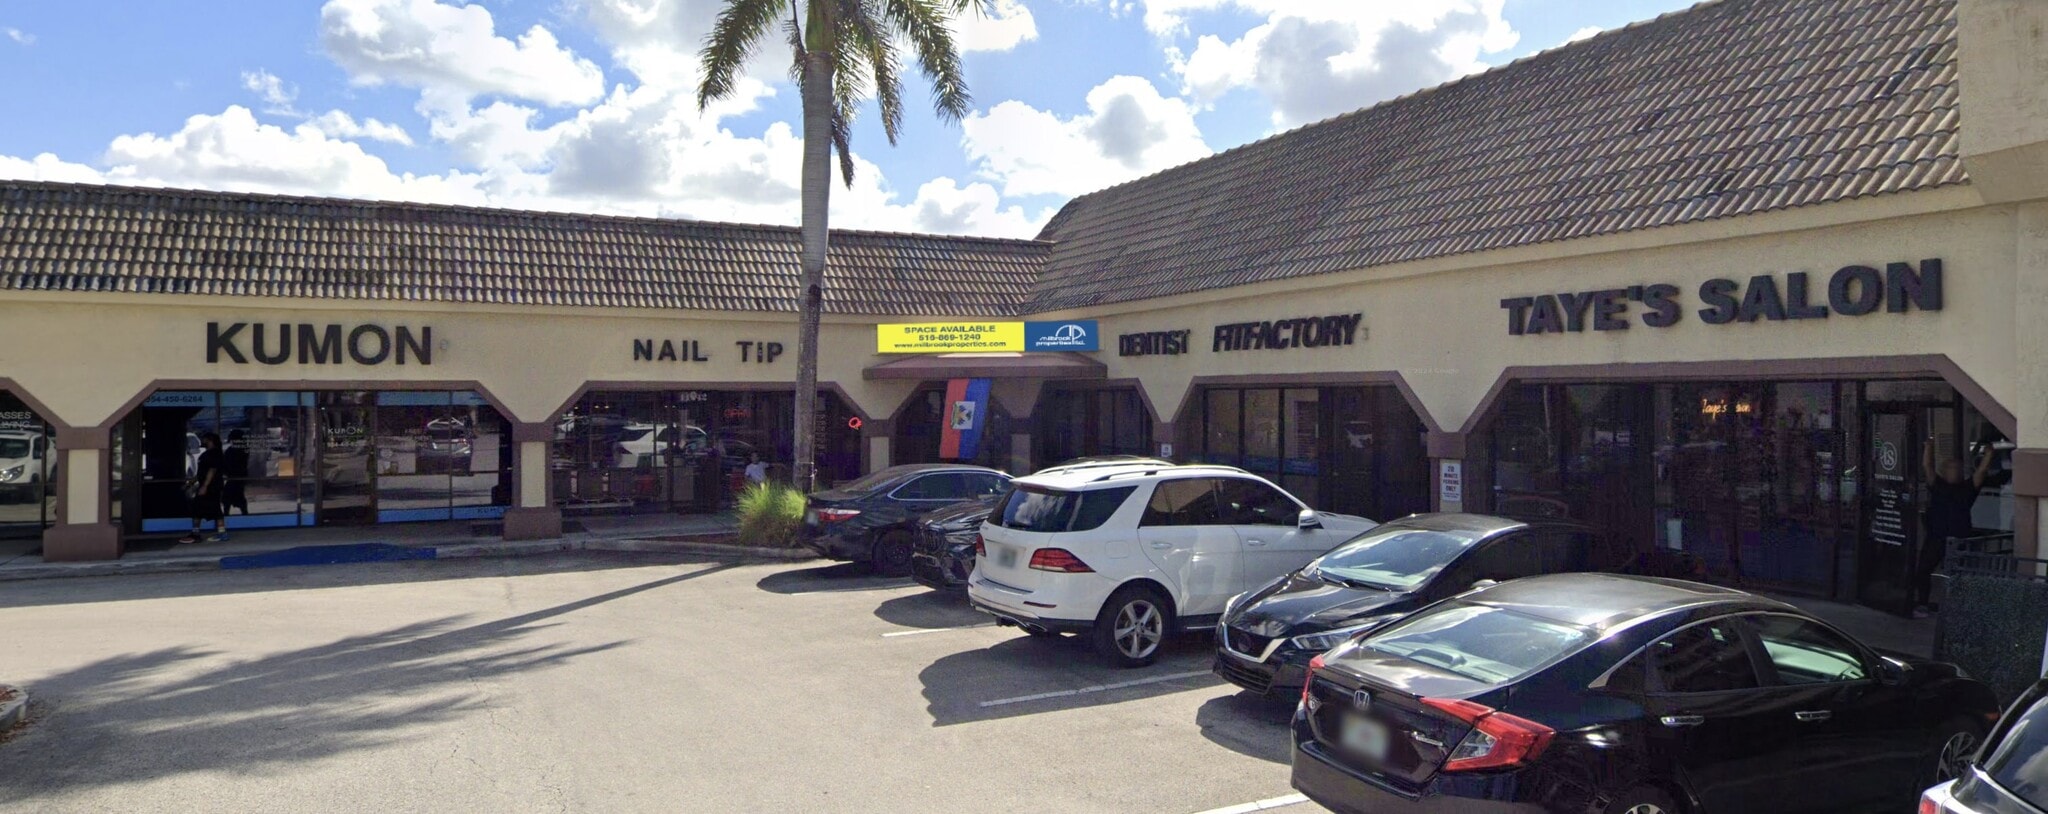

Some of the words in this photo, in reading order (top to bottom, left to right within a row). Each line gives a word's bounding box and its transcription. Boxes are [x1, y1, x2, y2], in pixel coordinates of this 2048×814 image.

[1500, 283, 1682, 336] TAYE'S
[1697, 258, 1943, 325] SALON
[940, 325, 996, 333] AVAILABLE
[1119, 329, 1191, 356] DENTIST
[206, 321, 432, 366] KUMON
[633, 338, 708, 362] NAIL
[735, 341, 784, 363] TIP
